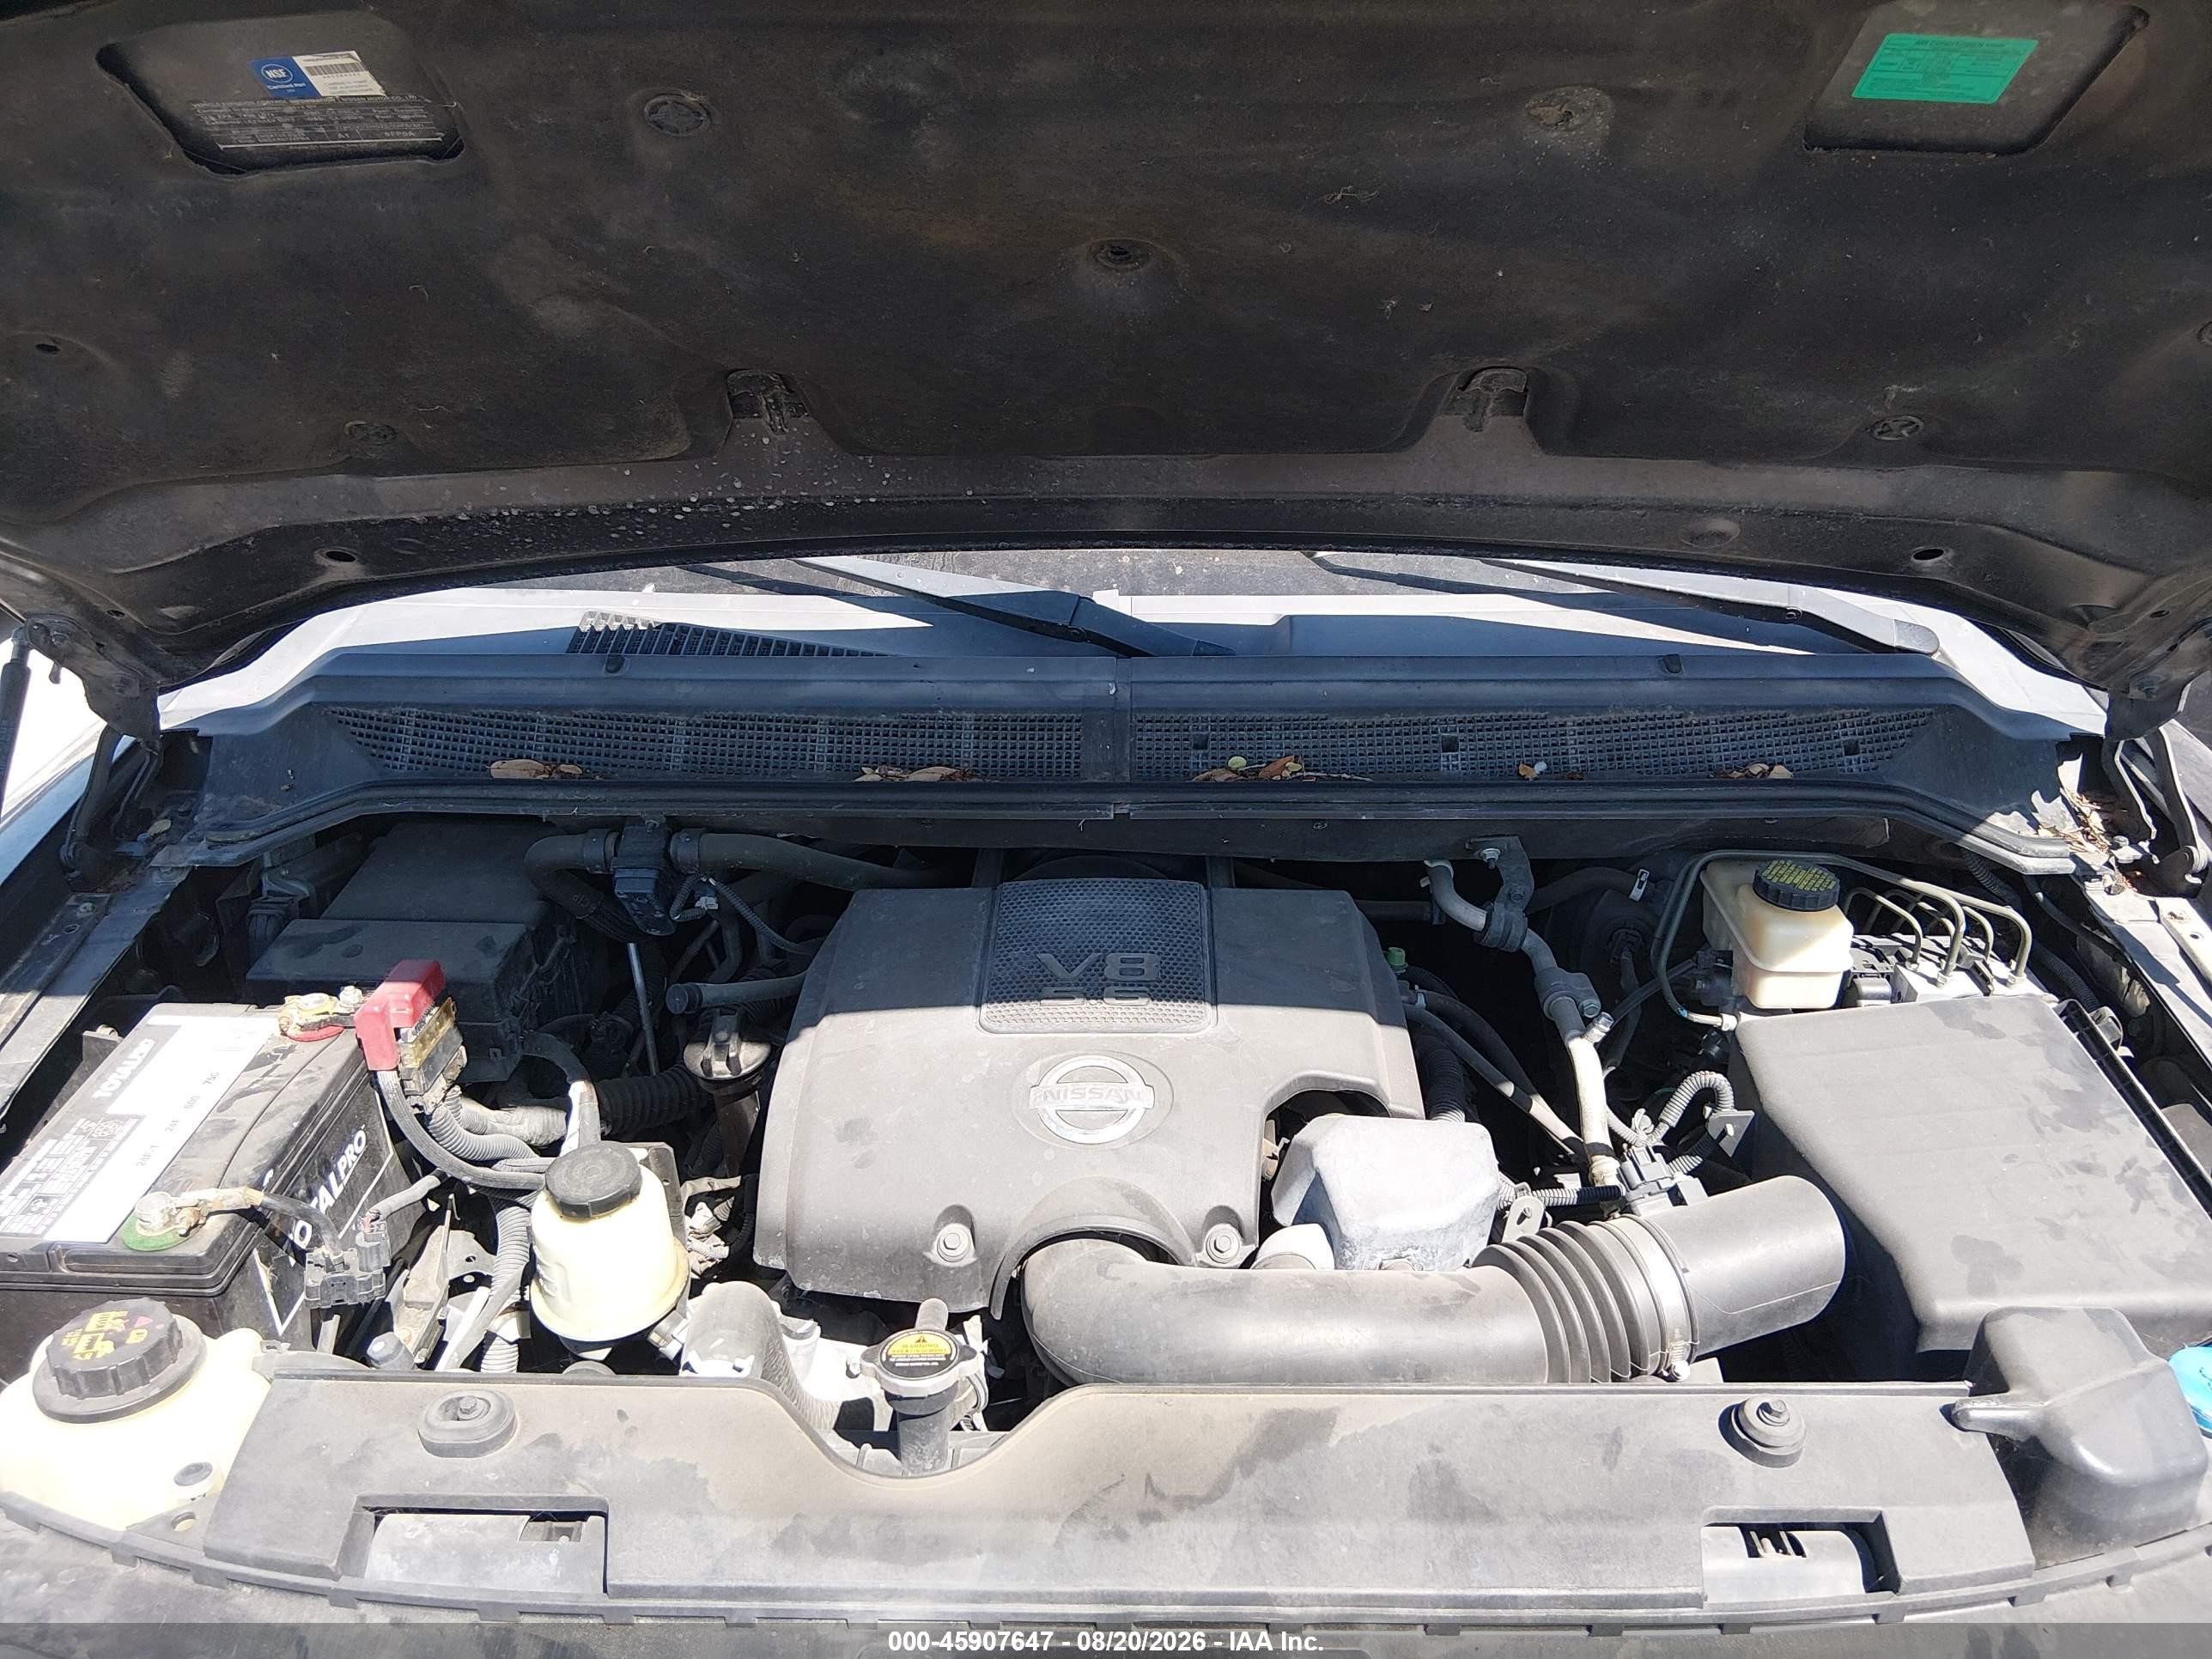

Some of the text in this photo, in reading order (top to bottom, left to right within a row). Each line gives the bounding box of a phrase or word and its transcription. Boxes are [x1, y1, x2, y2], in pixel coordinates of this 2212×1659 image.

[264, 69, 288, 79] NSF
[1036, 952, 1160, 982] V8
[1042, 1086, 1141, 1102] NISSAN
